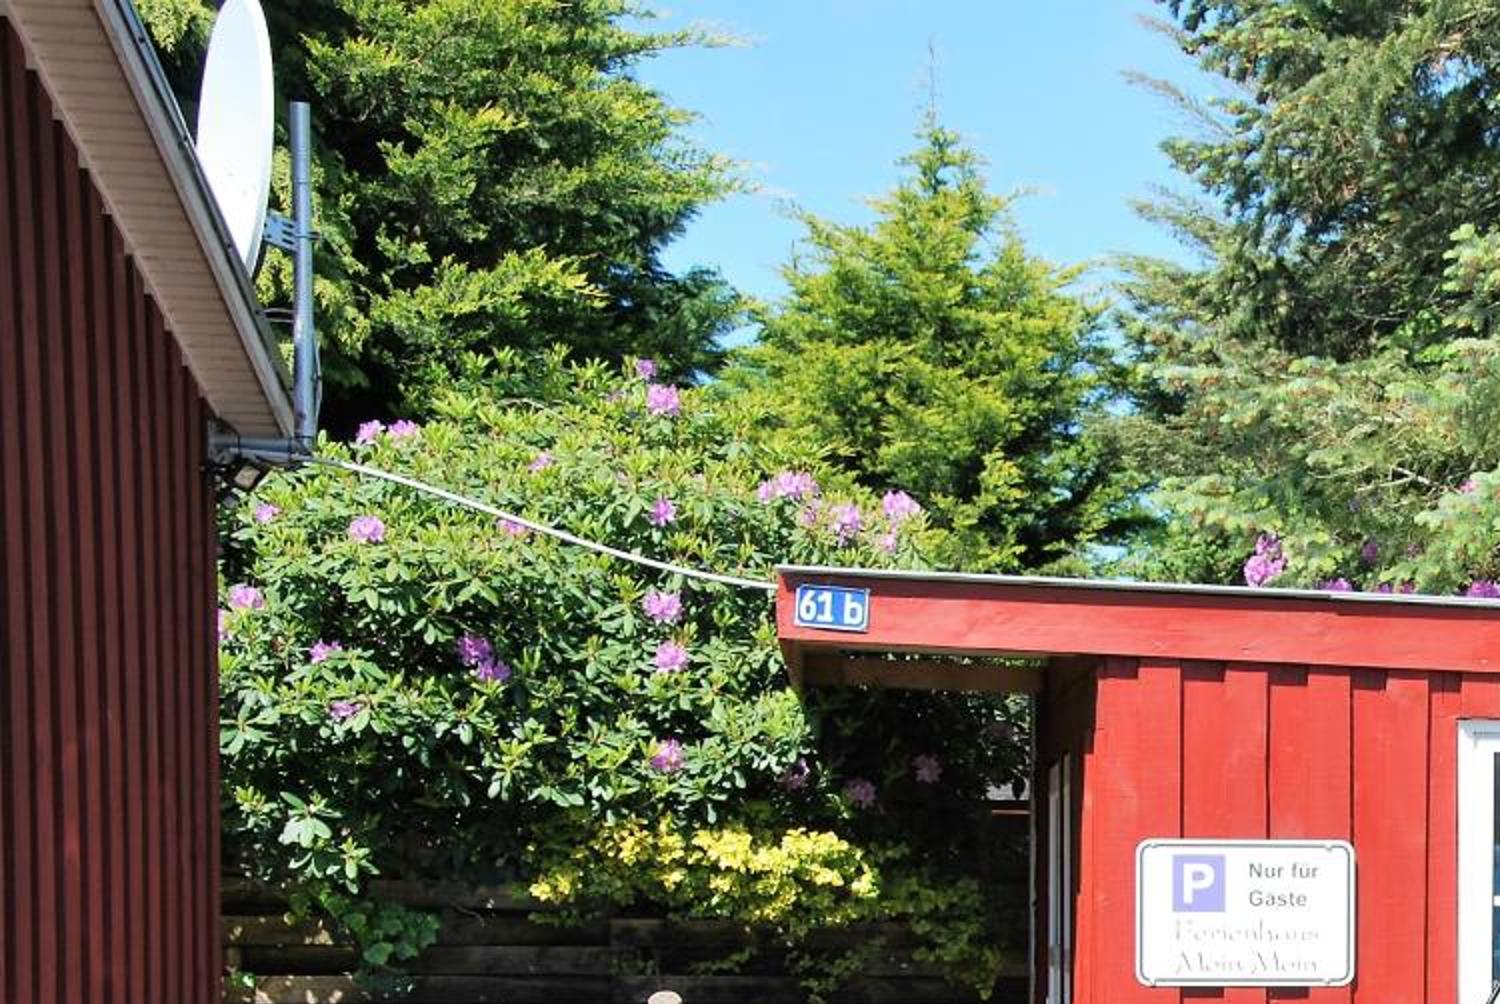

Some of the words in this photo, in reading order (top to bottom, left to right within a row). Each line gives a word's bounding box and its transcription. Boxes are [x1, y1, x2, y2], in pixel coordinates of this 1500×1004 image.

[800, 589, 833, 622] 61
[843, 592, 863, 625] b
[1183, 863, 1215, 904] P
[1249, 863, 1284, 878] Nur
[1291, 863, 1319, 878] für
